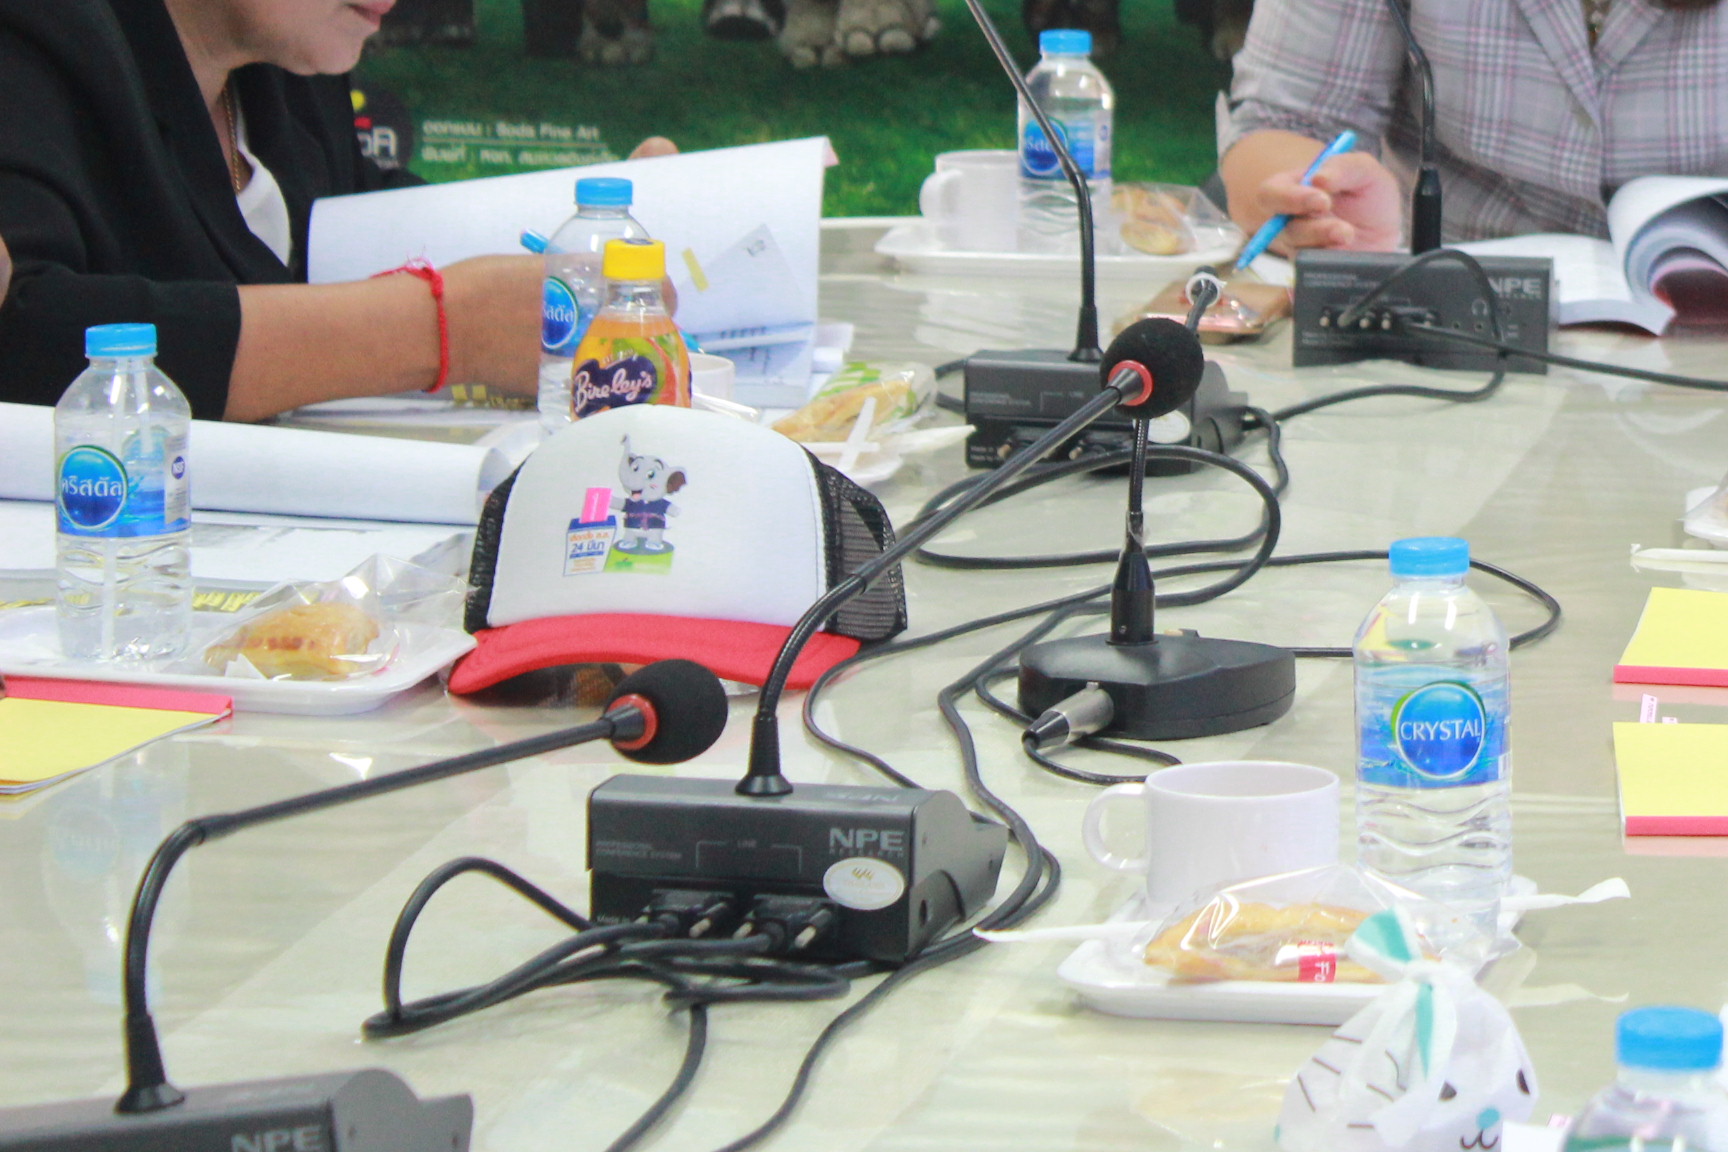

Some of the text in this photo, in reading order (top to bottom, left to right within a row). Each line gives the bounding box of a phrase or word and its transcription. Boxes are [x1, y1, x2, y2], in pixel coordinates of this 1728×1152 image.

[574, 368, 653, 414] Bireley's
[1400, 718, 1481, 741] CRYSTAL
[828, 827, 905, 851] NPE
[231, 1126, 322, 1152] NPE
